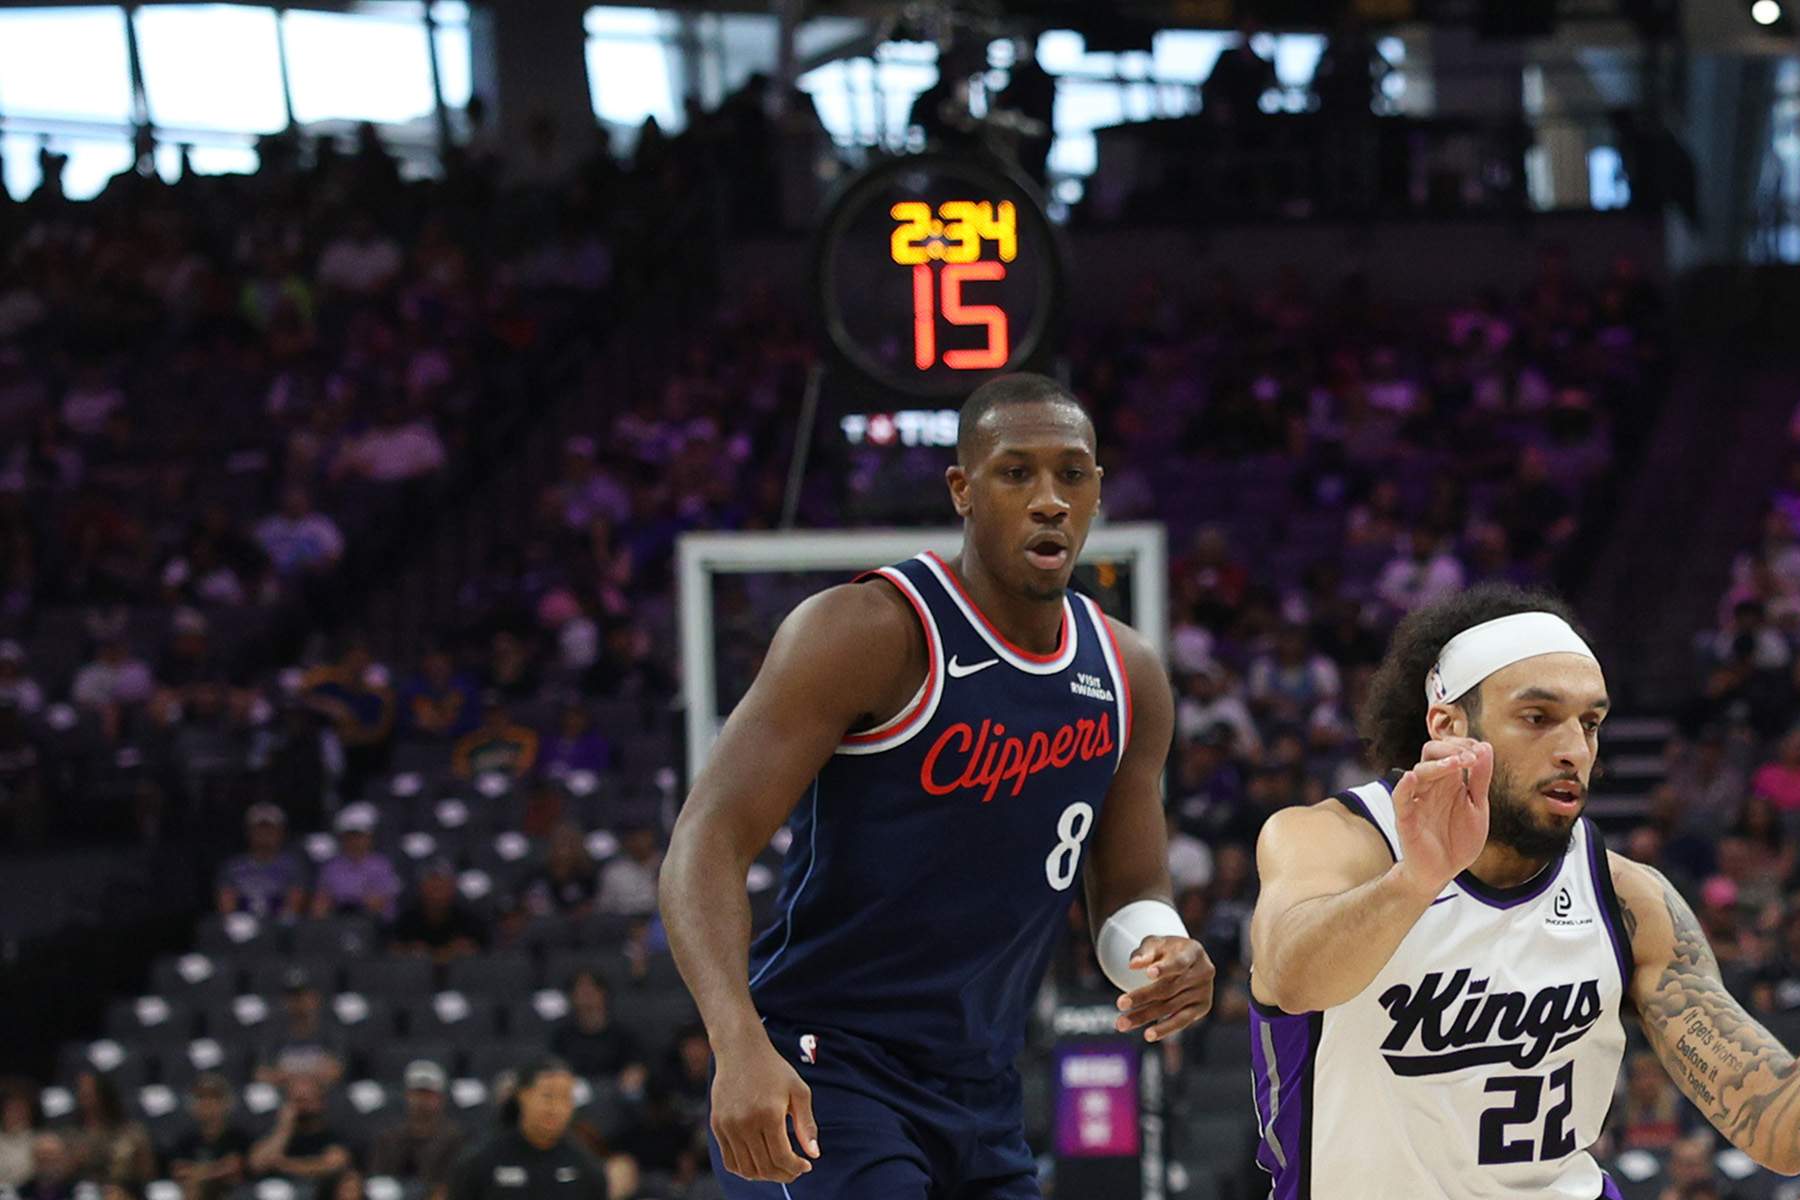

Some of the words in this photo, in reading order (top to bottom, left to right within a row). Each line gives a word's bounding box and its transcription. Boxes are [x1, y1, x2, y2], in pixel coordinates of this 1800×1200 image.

[890, 200, 1018, 265] 2:34
[913, 260, 1009, 371] 15
[1070, 681, 1114, 702] RWANDA
[1077, 672, 1101, 689] VISIT
[920, 711, 1114, 802] Clippers
[1045, 801, 1094, 892] 8
[1378, 967, 1603, 1077] Kings
[1675, 1033, 1710, 1075] before
[1478, 1059, 1576, 1165] 22
